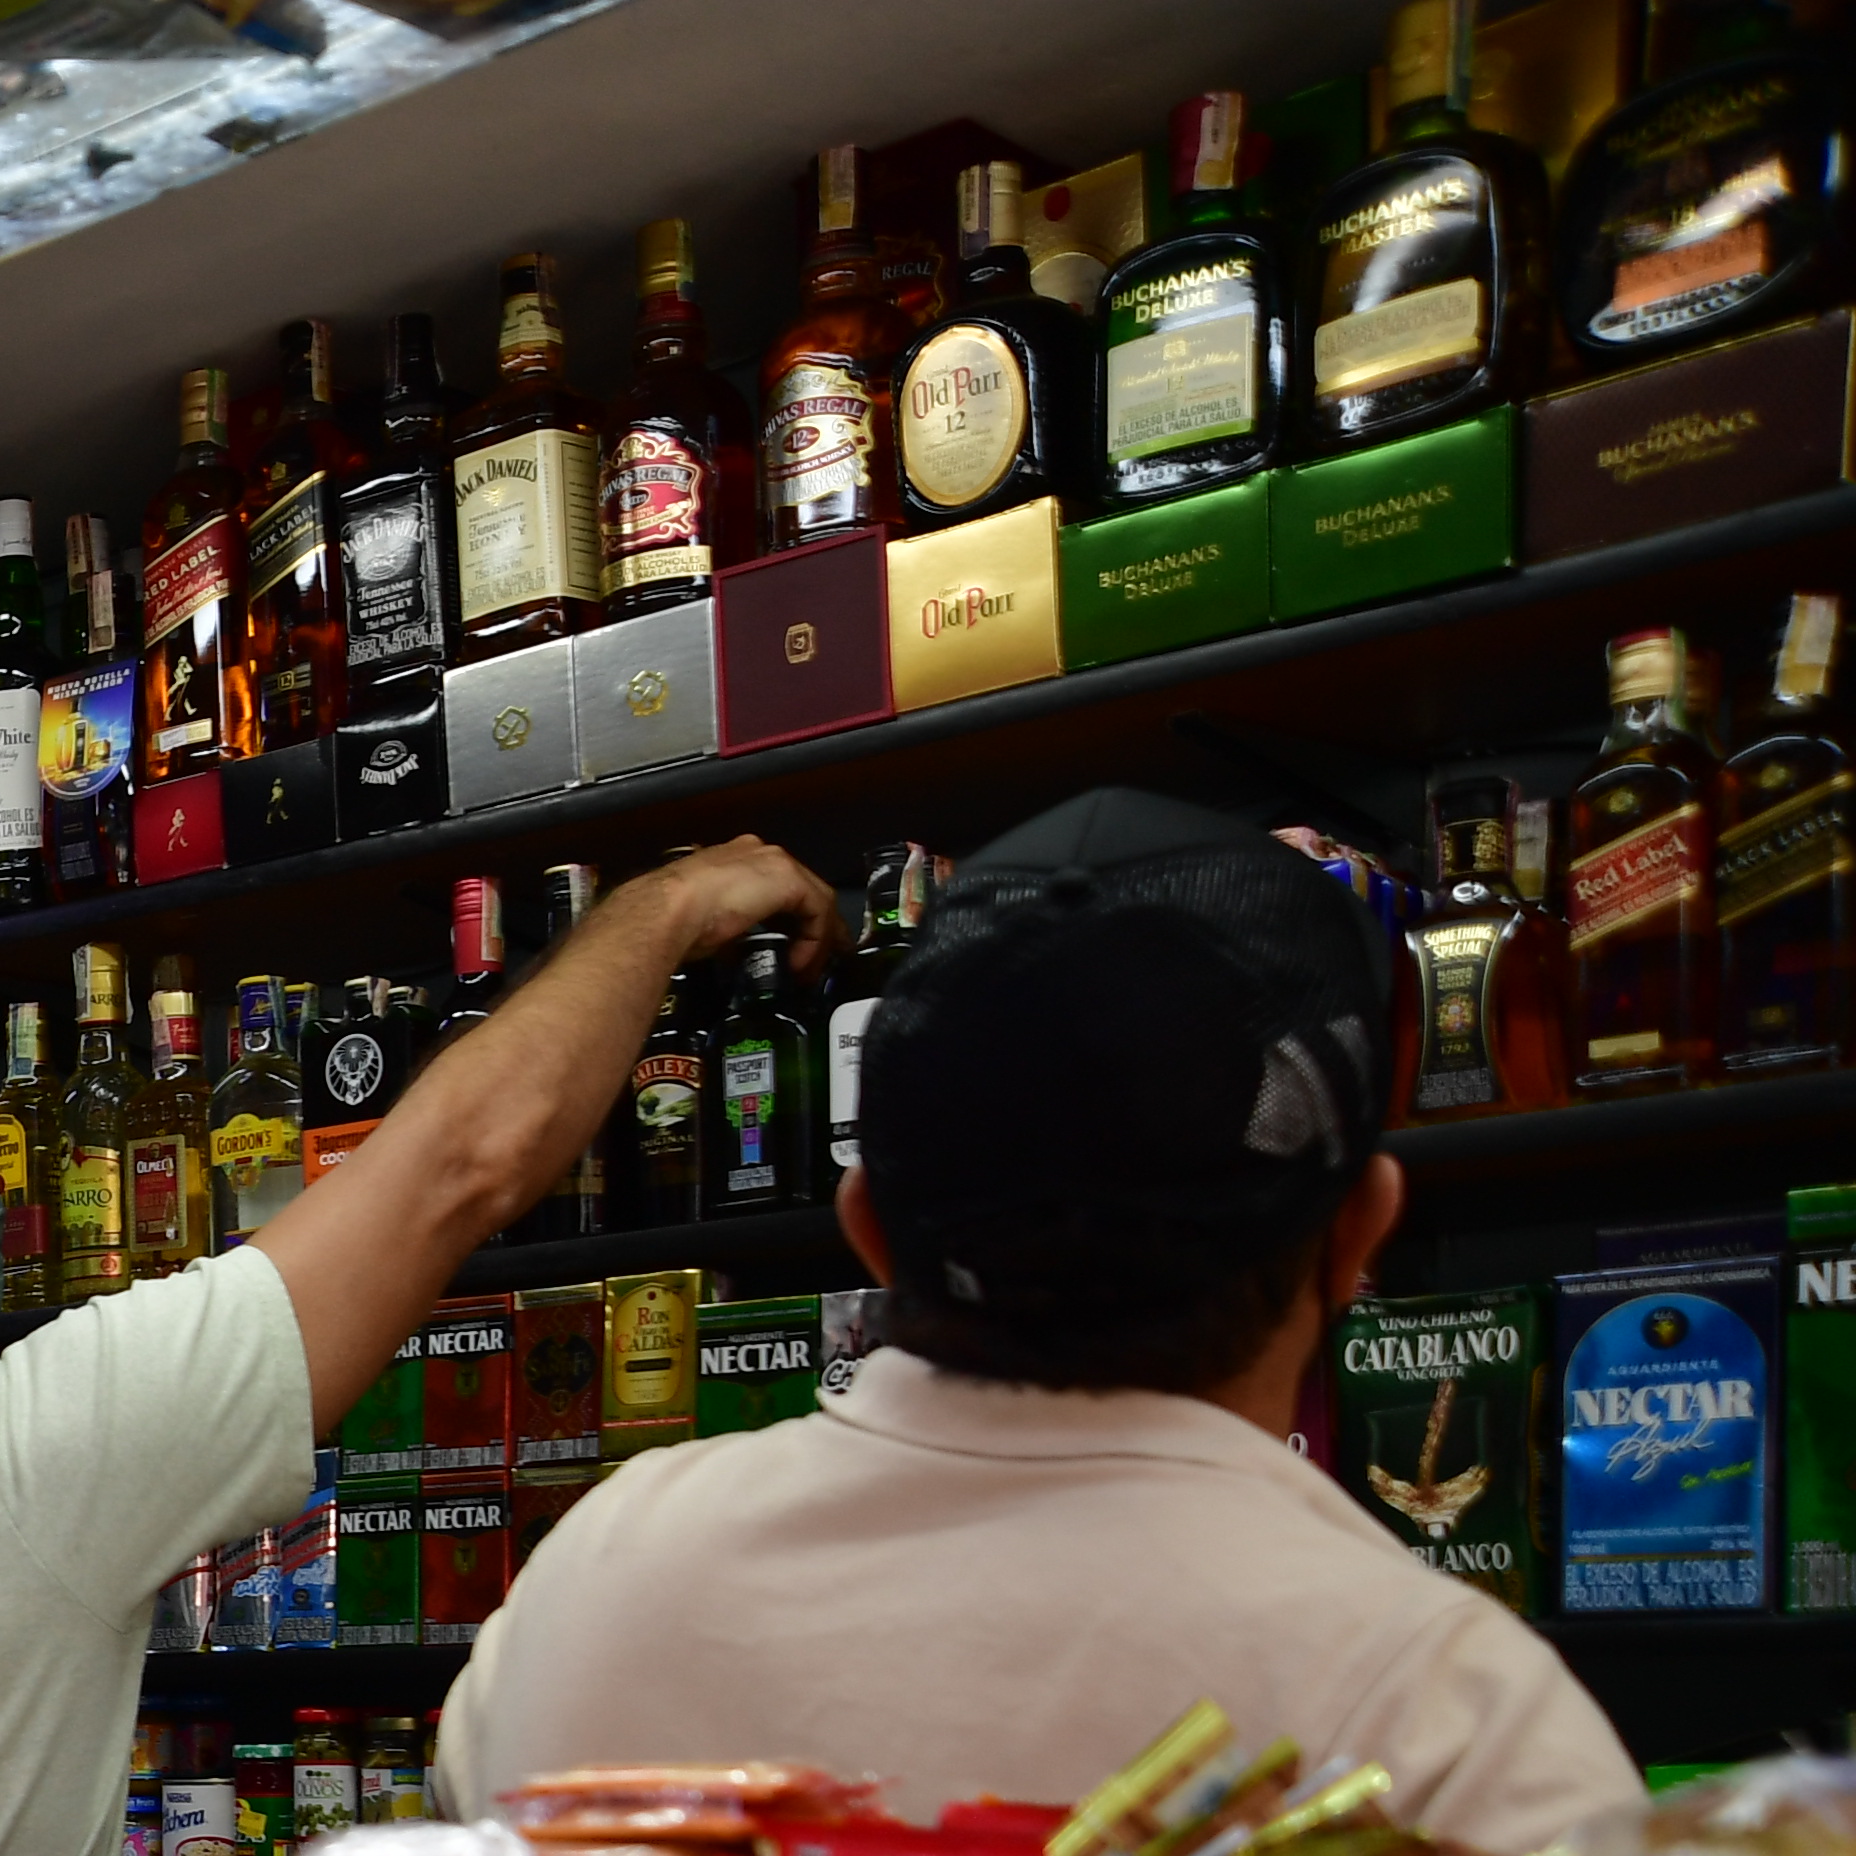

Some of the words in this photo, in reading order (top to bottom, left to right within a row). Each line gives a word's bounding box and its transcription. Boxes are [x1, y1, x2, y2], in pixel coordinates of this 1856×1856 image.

[1319, 176, 1470, 245] BUCHANAN'S
[1110, 255, 1250, 312] BUCHANAN'S
[1134, 286, 1215, 324] DELUXE
[802, 396, 863, 418] REGAL
[910, 375, 950, 421] Old
[950, 365, 1003, 410] Parr
[943, 411, 967, 434] 12
[791, 431, 810, 447] 12
[1314, 484, 1454, 535] BUCHANAN'S
[171, 544, 223, 582] LABEL
[920, 593, 963, 640] Old
[964, 585, 1016, 631] Parr
[1575, 861, 1615, 903] Red
[1616, 833, 1688, 880] Label
[1424, 922, 1495, 950] SOMETHING
[216, 1131, 273, 1155] GORDON'S
[1377, 1312, 1417, 1332] VINO
[1420, 1309, 1493, 1329] CHILENO
[428, 1328, 506, 1357] NECTAR
[614, 1330, 685, 1355] CALDAS
[1343, 1326, 1521, 1374] CATABLANCO
[699, 1339, 812, 1377] NECTAR
[1570, 1378, 1755, 1428] NECTAR
[339, 1508, 413, 1534] NECTAR
[424, 1504, 503, 1530] NECTAR
[1585, 1563, 1634, 1586] EXCESO
[1642, 1562, 1659, 1583] DE
[1666, 1560, 1730, 1585] ALCOHOL
[1739, 1559, 1757, 1581] ES
[1648, 1584, 1682, 1607] PARA
